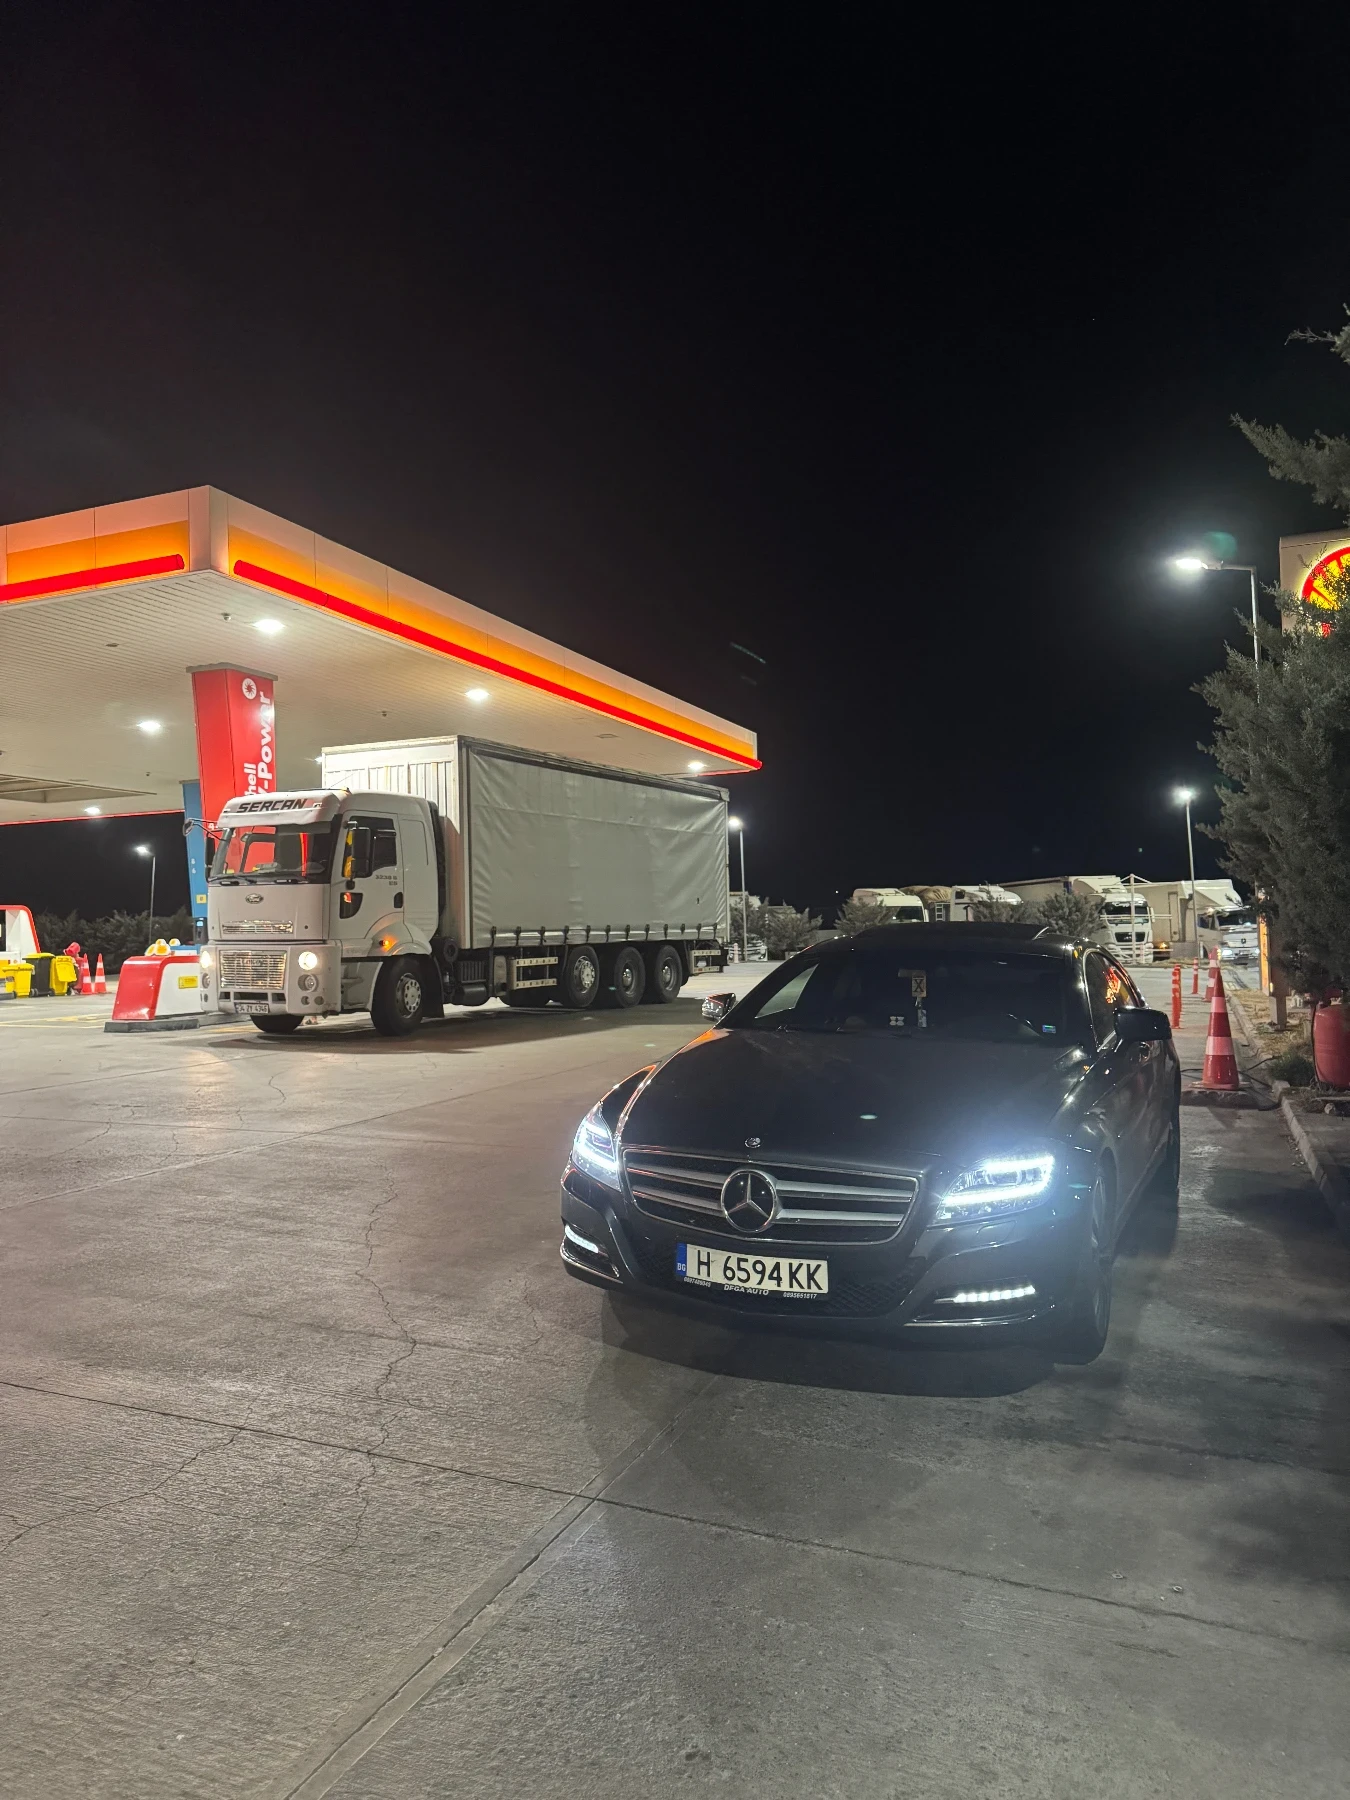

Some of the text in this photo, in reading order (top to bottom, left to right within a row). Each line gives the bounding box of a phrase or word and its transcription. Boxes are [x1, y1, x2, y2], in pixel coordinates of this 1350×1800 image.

[243, 763, 257, 796] hell
[237, 799, 307, 813] SERCAN
[677, 1262, 686, 1272] BG
[697, 1250, 823, 1291] H 6594 KK
[746, 1286, 770, 1296] AUTO
